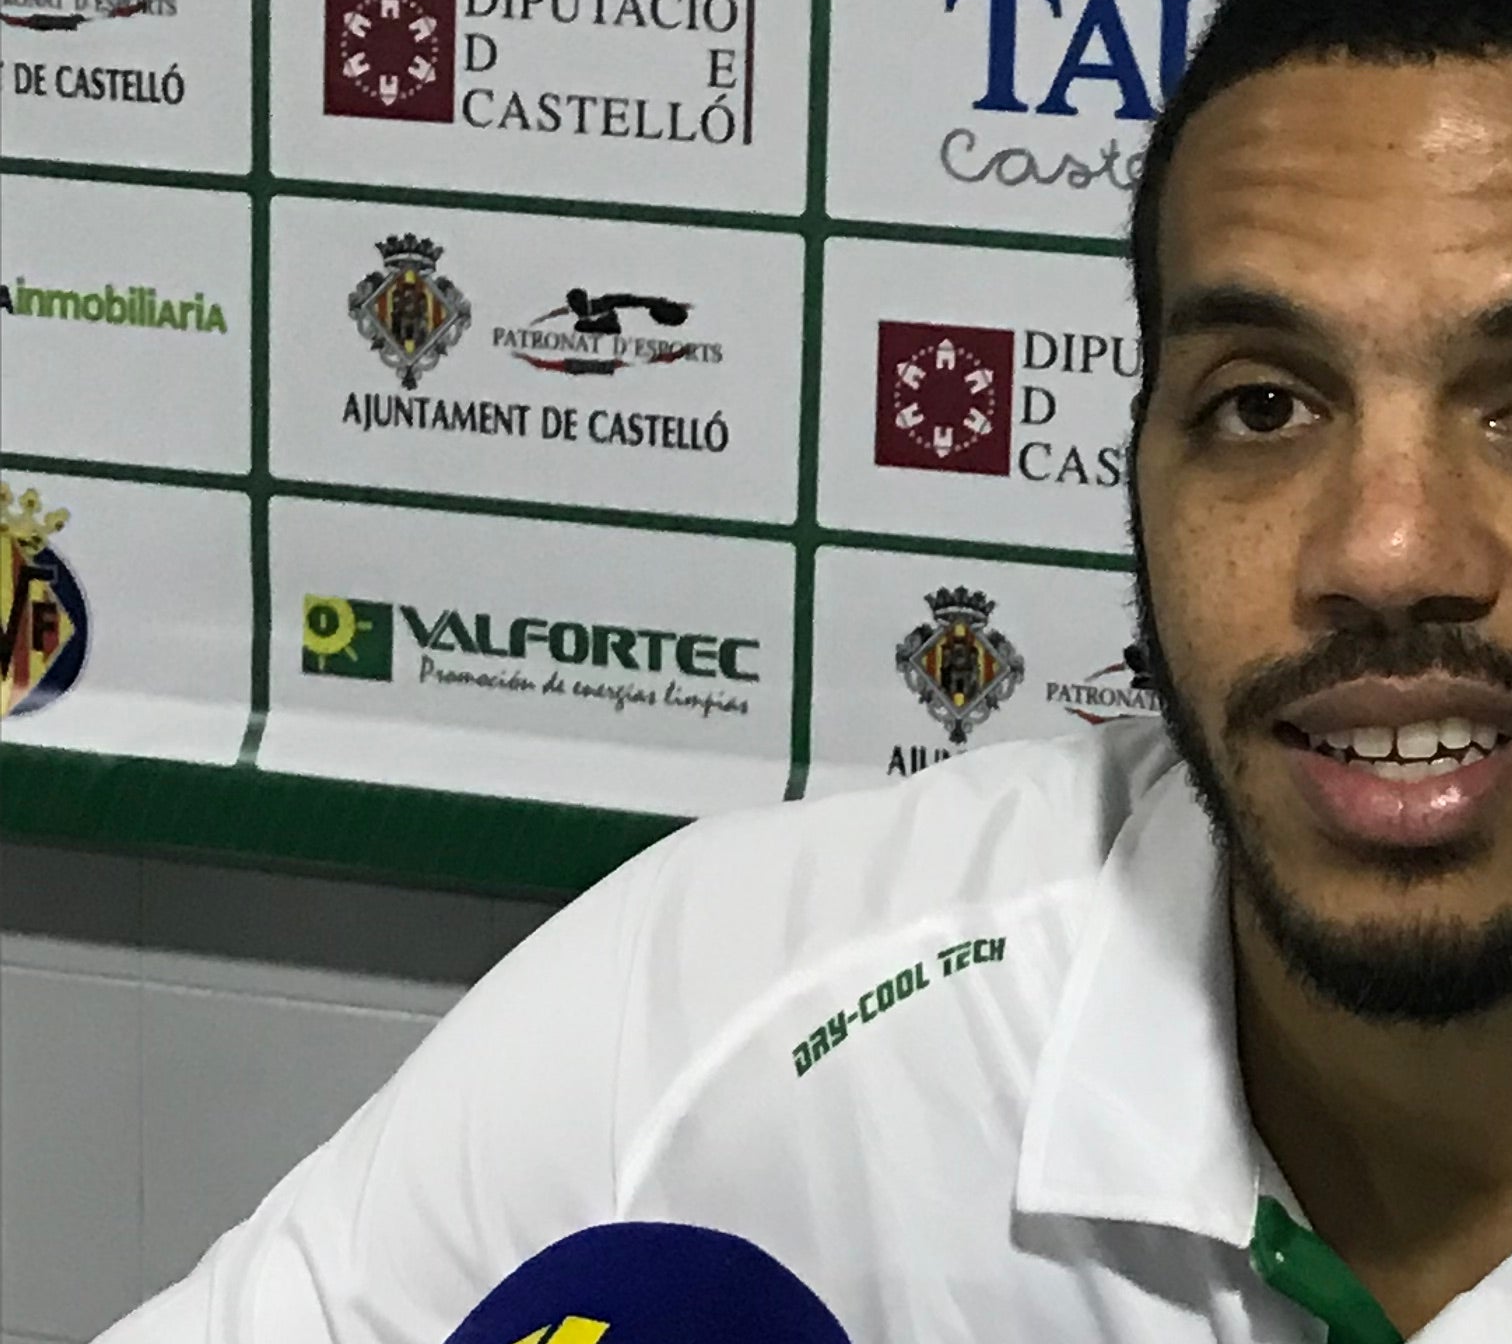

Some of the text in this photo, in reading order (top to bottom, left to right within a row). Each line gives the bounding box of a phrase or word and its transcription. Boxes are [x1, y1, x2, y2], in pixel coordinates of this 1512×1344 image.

[465, 34, 736, 88] D E
[14, 63, 47, 96] DE
[55, 63, 184, 105] CASTELLÓ
[462, 89, 735, 144] CASTELLÓ
[492, 327, 600, 354] PATRONAT
[343, 393, 728, 452] AJUNTAMENT DE CASTELLÓ
[1020, 386, 1057, 425] D
[400, 605, 760, 683] VALFORTEC
[543, 671, 565, 695] de
[937, 936, 1006, 977] TECH
